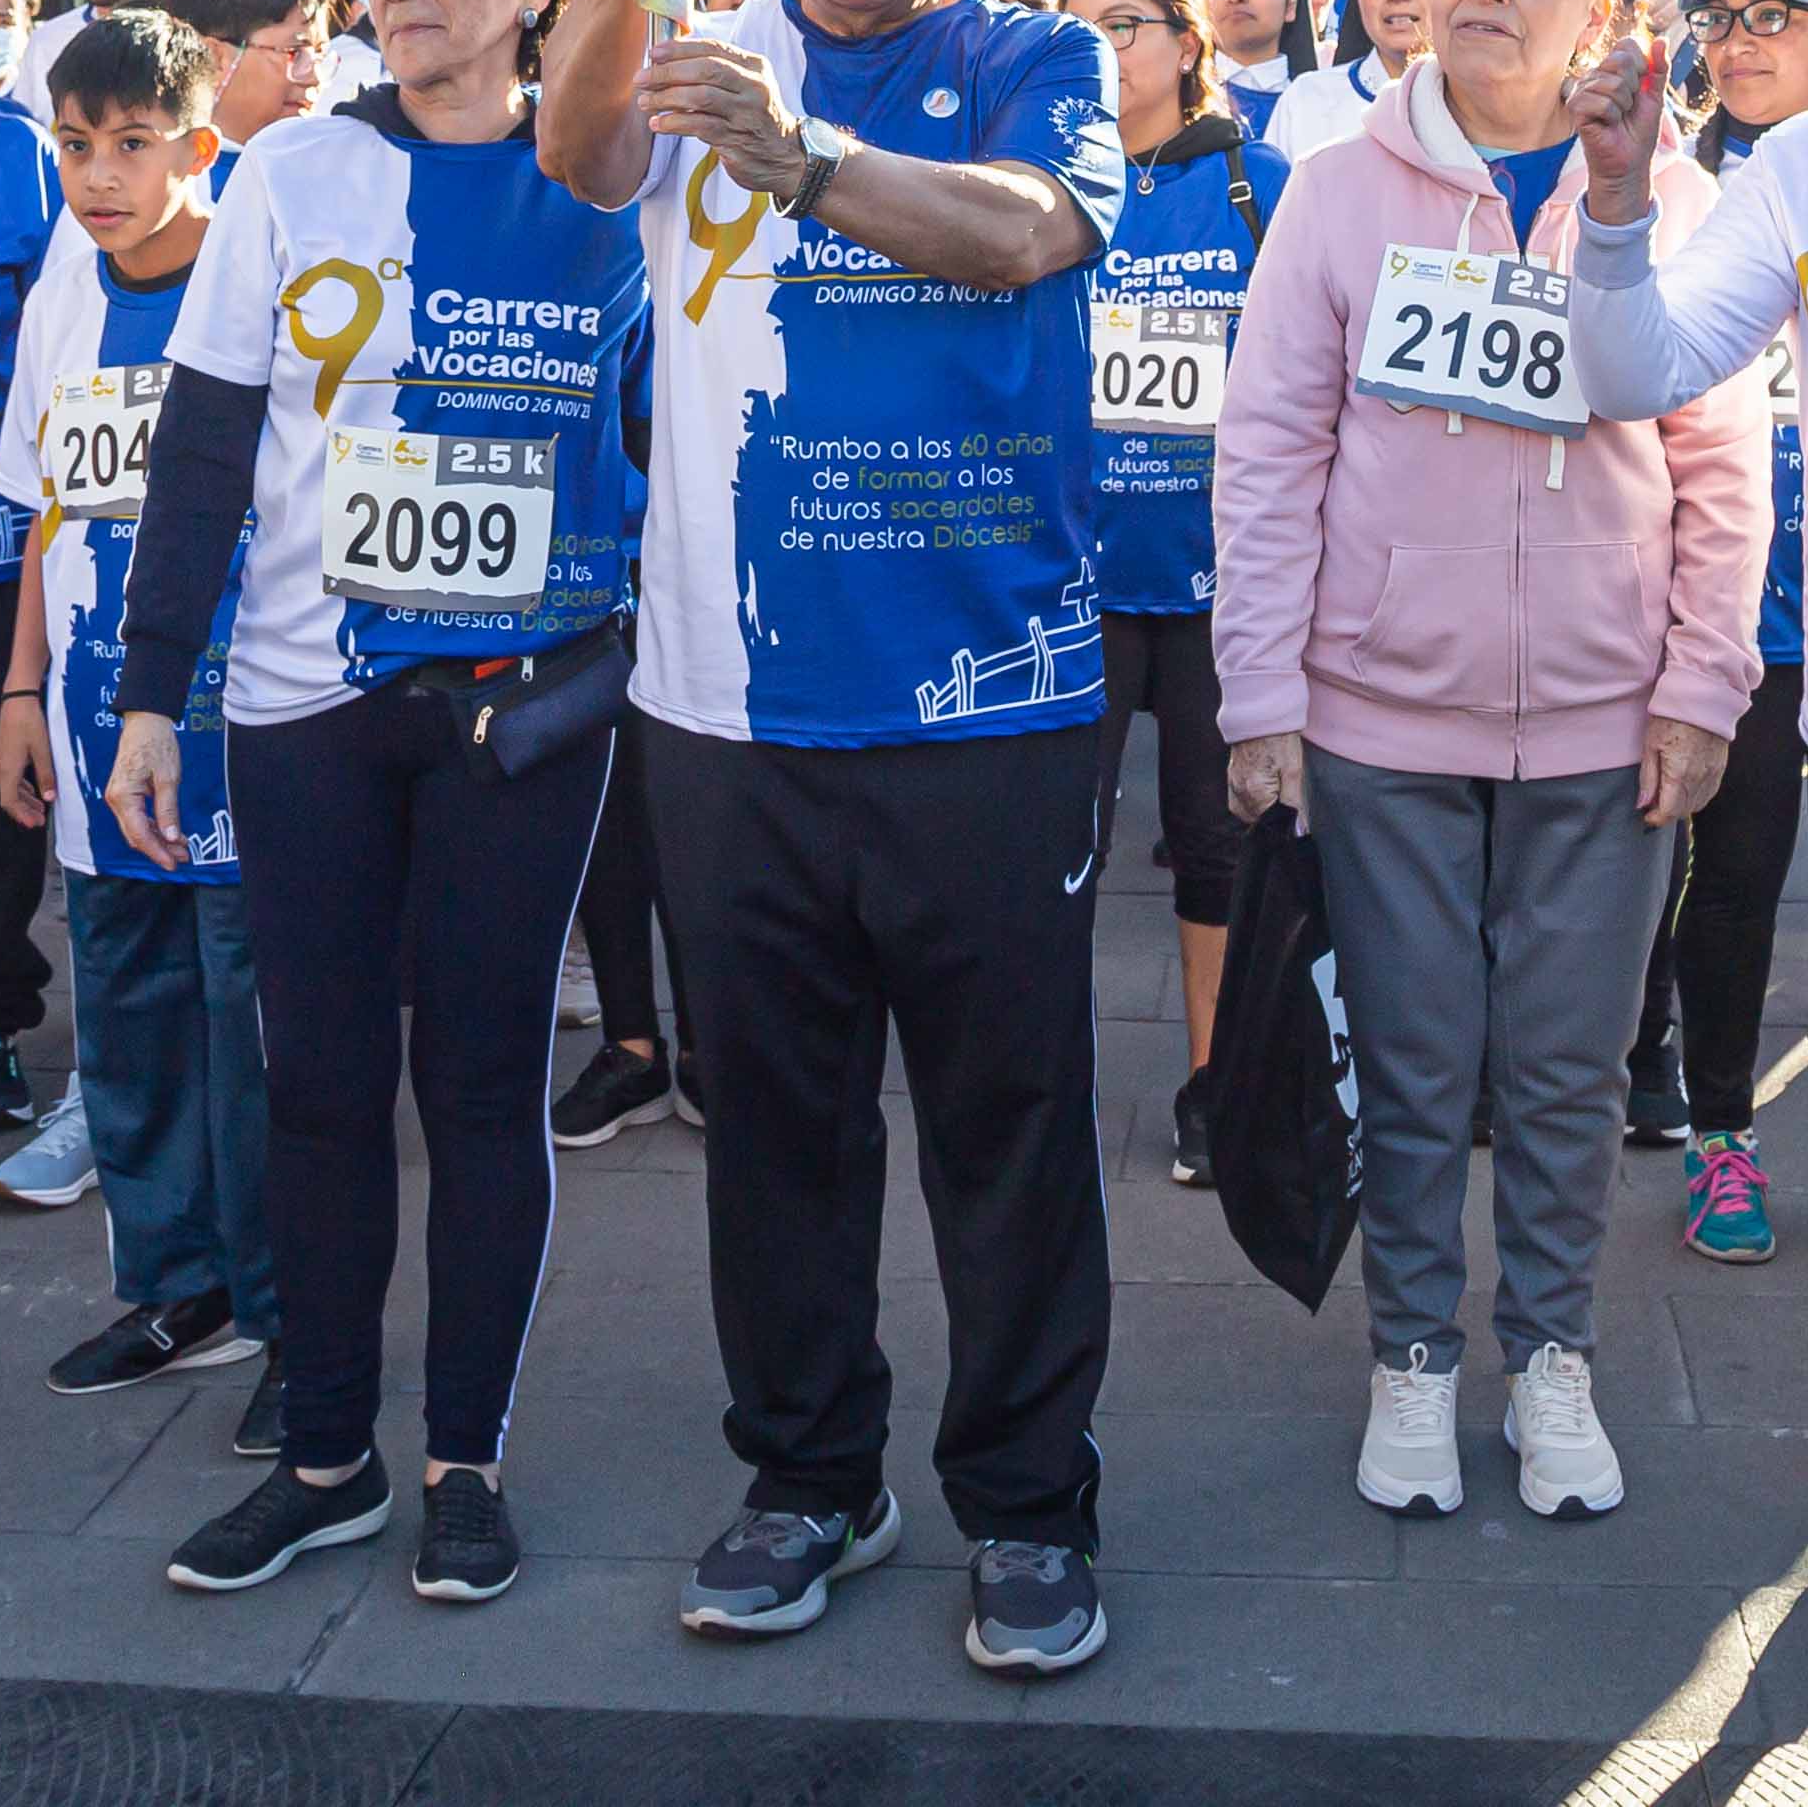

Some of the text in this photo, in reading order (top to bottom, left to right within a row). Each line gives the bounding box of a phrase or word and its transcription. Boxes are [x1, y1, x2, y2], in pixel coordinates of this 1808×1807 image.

[1105, 248, 1238, 277] Carrera
[1121, 273, 1183, 290] por las
[1508, 269, 1569, 305] 2.5
[815, 286, 916, 304] DOMINGO
[919, 285, 944, 303] 26
[948, 285, 988, 303] NOV
[1095, 284, 1247, 309] Vocaciones
[426, 289, 601, 337] Carrera
[1150, 311, 1220, 337] 2.5 k
[449, 327, 535, 349] por las
[1385, 304, 1565, 400] 2198
[418, 345, 598, 389] Vocaciones
[436, 392, 578, 417] DOMINGO 26 NOV
[769, 432, 1054, 460] “Rumbo a los 60 años
[1123, 438, 1149, 455] de
[451, 443, 545, 476] 2.5 k
[1108, 456, 1170, 474] futuros
[812, 463, 1014, 490] de formar a los
[1100, 476, 1199, 493] de nuestra
[790, 492, 1035, 520] futuros sacerdotes
[344, 492, 518, 578] 2099
[780, 526, 814, 550] de
[823, 526, 925, 551] nuestra
[569, 560, 593, 582] los
[423, 608, 513, 630] nuestra
